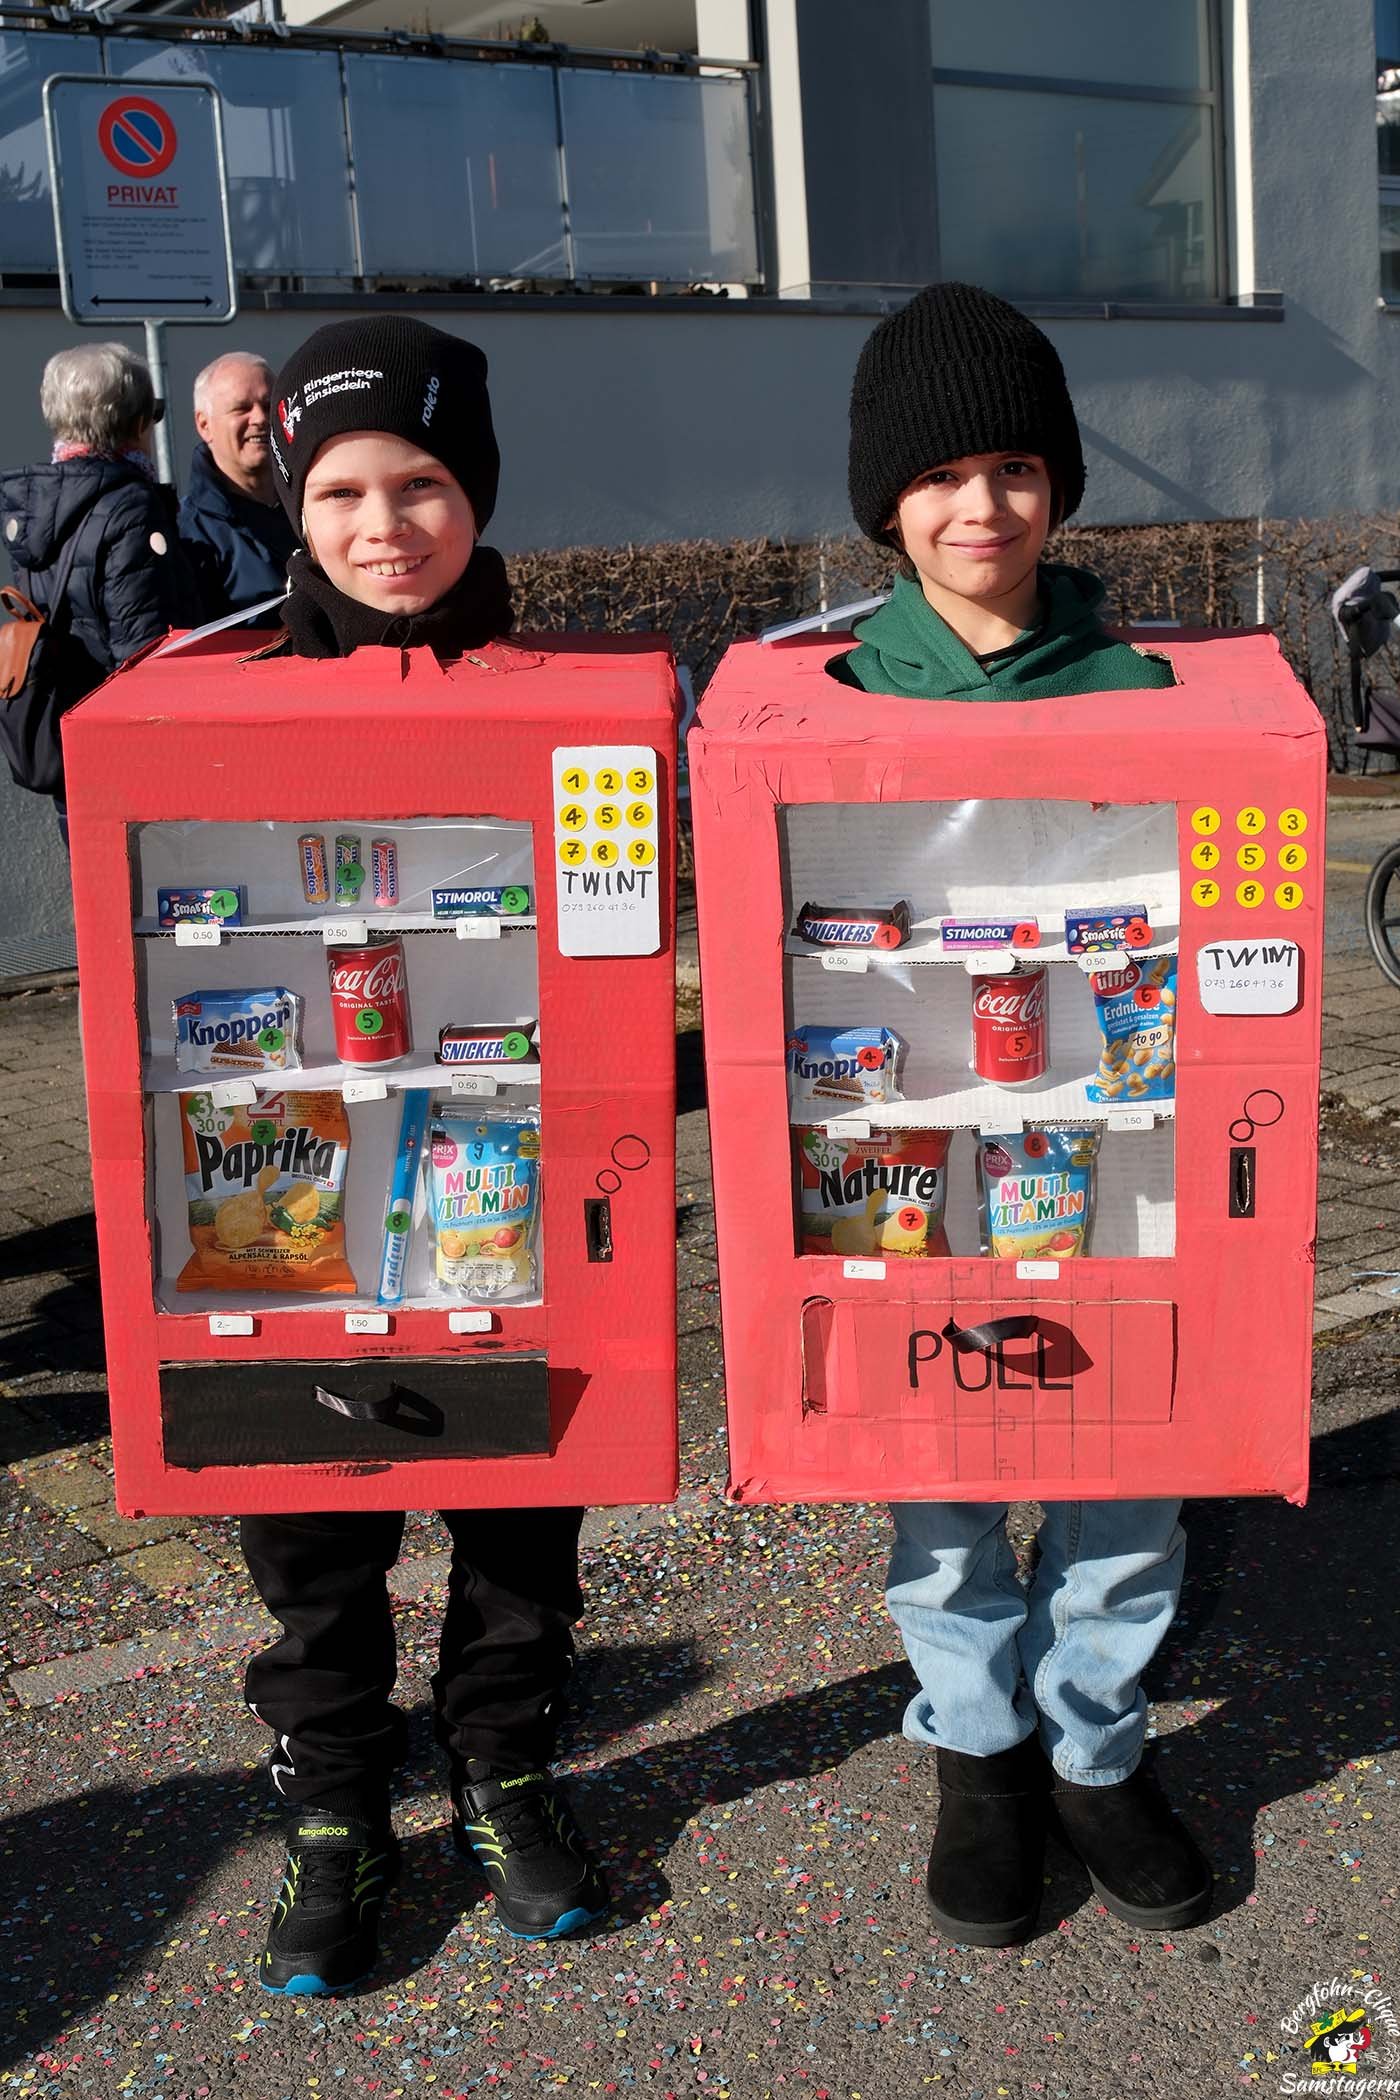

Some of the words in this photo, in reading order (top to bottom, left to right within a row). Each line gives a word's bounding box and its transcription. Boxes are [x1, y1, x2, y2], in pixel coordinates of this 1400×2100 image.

[107, 185, 178, 203] PRIVAT
[304, 368, 384, 394] Ringerriege
[305, 378, 371, 407] Einsiedeln
[568, 774, 579, 788] 1
[603, 774, 613, 789] 2
[634, 771, 647, 788] 3
[566, 808, 581, 825] 4
[602, 807, 613, 823] 5
[632, 805, 645, 821] 6
[1200, 815, 1210, 827] 1
[1246, 812, 1256, 827] 2
[1287, 814, 1298, 830] 3
[567, 842, 579, 858] 7
[597, 845, 608, 860] 8
[635, 843, 645, 859] 9
[1200, 845, 1213, 861] 4
[1244, 848, 1258, 864] 5
[1286, 849, 1298, 864] 6
[304, 846, 317, 896] mentos
[344, 868, 357, 881] 2
[562, 869, 653, 898] TWINT
[436, 891, 498, 904] STIMOROL
[506, 891, 519, 906] 3
[1200, 884, 1213, 899] 7
[1244, 885, 1256, 901] 8
[1283, 886, 1294, 903] 9
[215, 896, 225, 911] 1
[193, 931, 213, 939] 0.50
[327, 928, 347, 937] 0.50
[804, 921, 876, 942] SNICKERS
[881, 930, 892, 943] 1
[946, 928, 1007, 939] STIMOROL
[1022, 930, 1035, 943] 2
[1132, 927, 1145, 940] 3
[828, 957, 848, 965] 0.50
[1086, 957, 1106, 967] 0.50
[1205, 945, 1296, 970] TWINT
[1141, 988, 1152, 1003] 6
[362, 1012, 374, 1028] 5
[264, 1031, 278, 1045] 4
[508, 1038, 519, 1052] 6
[1014, 1036, 1027, 1052] 5
[1133, 1034, 1146, 1046] to
[1149, 1031, 1162, 1046] go
[864, 1051, 877, 1063] 4
[458, 1081, 477, 1089] 0.50
[197, 1119, 215, 1132] 30
[1125, 1117, 1142, 1125] 1.50
[474, 1142, 485, 1160] 9
[195, 1128, 336, 1192] Paprika
[813, 1154, 829, 1167] 30
[445, 1162, 516, 1195] MULTI
[820, 1159, 937, 1208] Nature
[1001, 1171, 1070, 1203] MULTI
[439, 1184, 530, 1221] VITAMIN
[989, 1190, 1085, 1227] VITAMIN
[905, 1213, 919, 1226] 7
[280, 1253, 308, 1261] RAPSÖL
[217, 1320, 231, 1328] 2.-
[351, 1319, 368, 1327] 1.50
[908, 1330, 1073, 1392] PULL
[298, 1827, 349, 1837] KangaROOS
